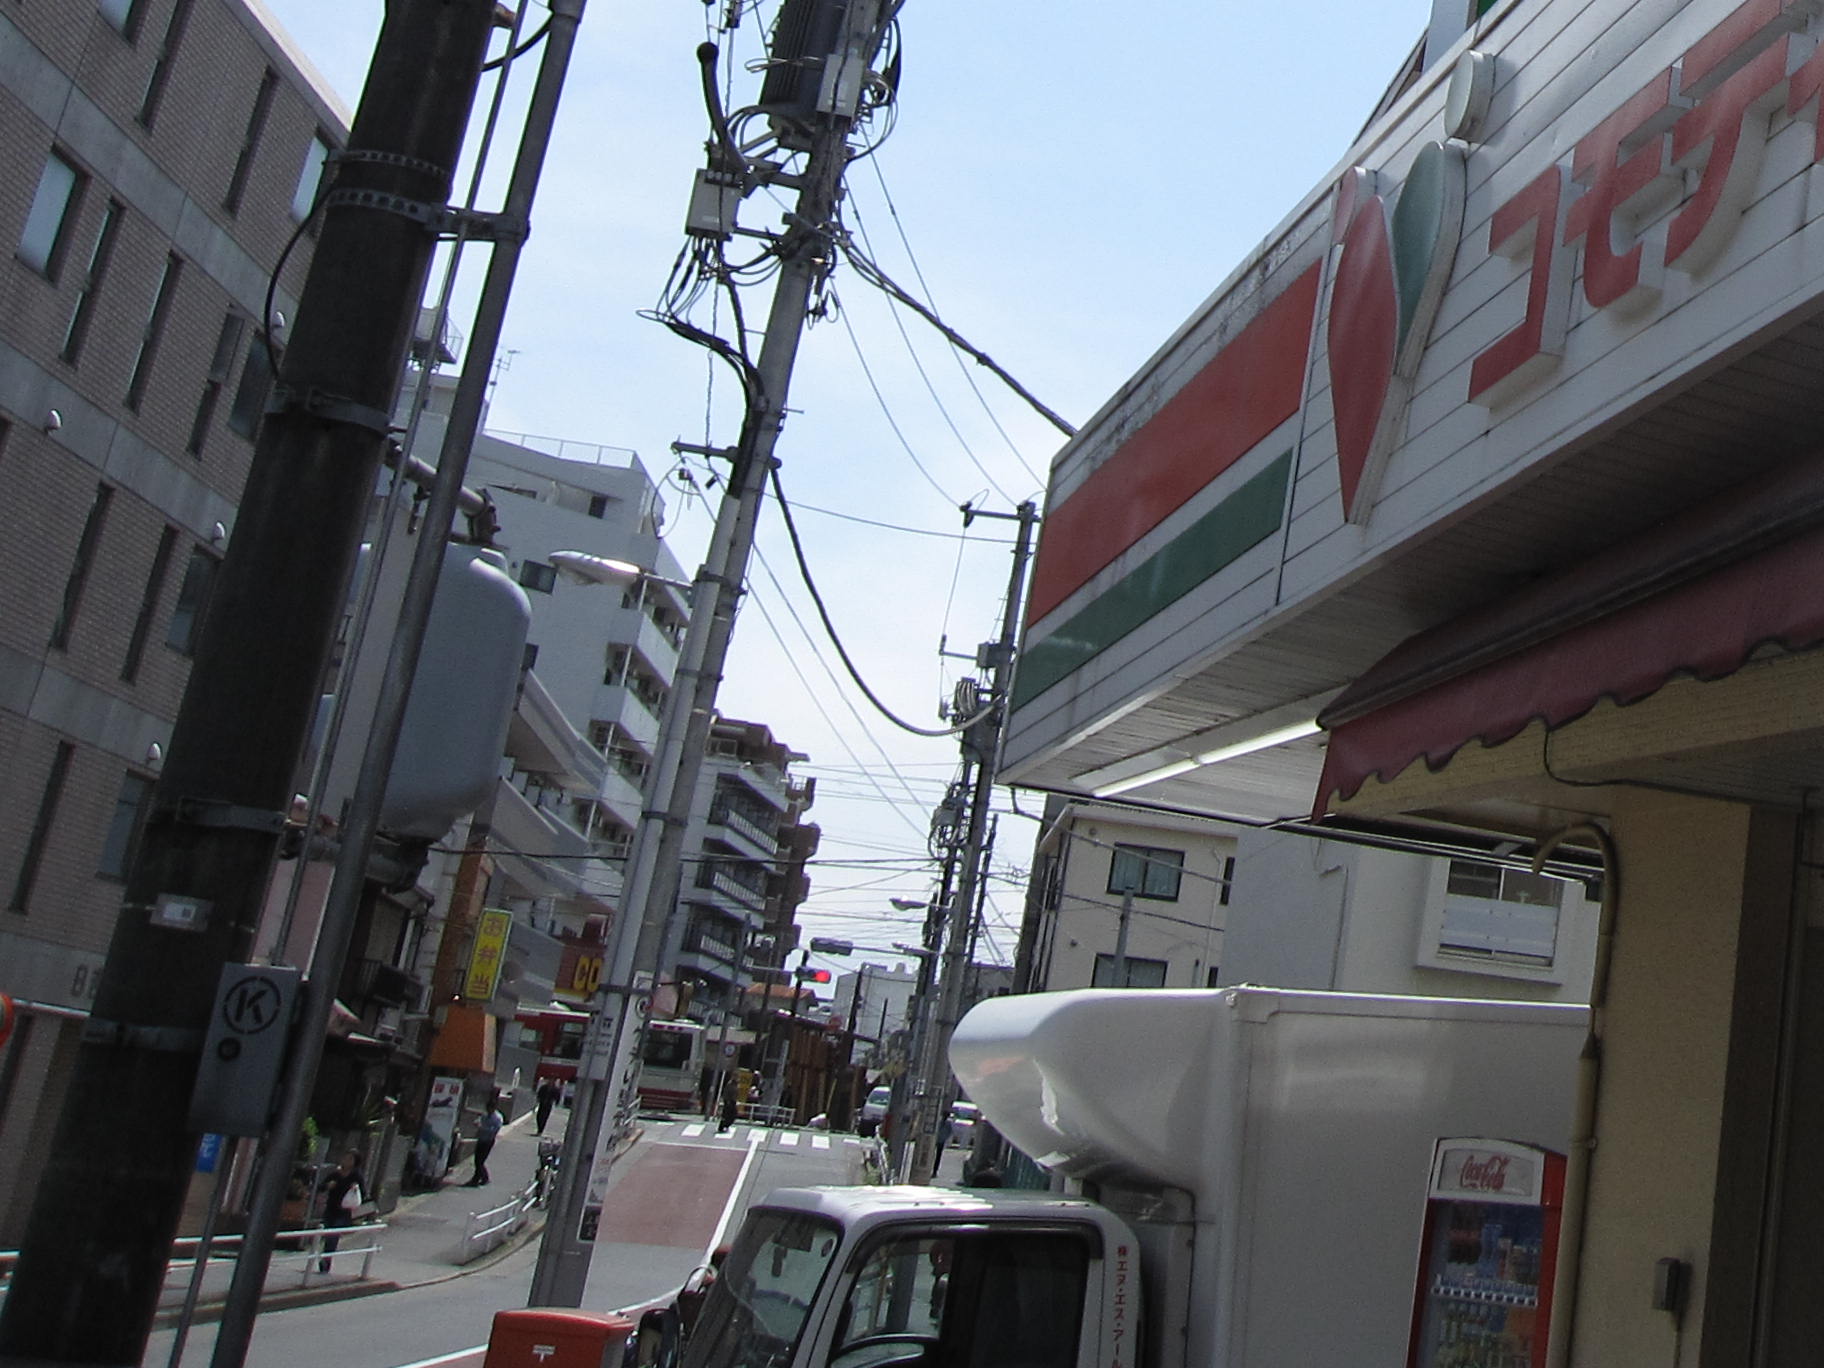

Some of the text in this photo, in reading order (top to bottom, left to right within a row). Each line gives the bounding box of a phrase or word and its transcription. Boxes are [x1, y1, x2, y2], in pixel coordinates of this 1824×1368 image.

[467, 916, 505, 996] お弁当
[234, 987, 271, 1024] K
